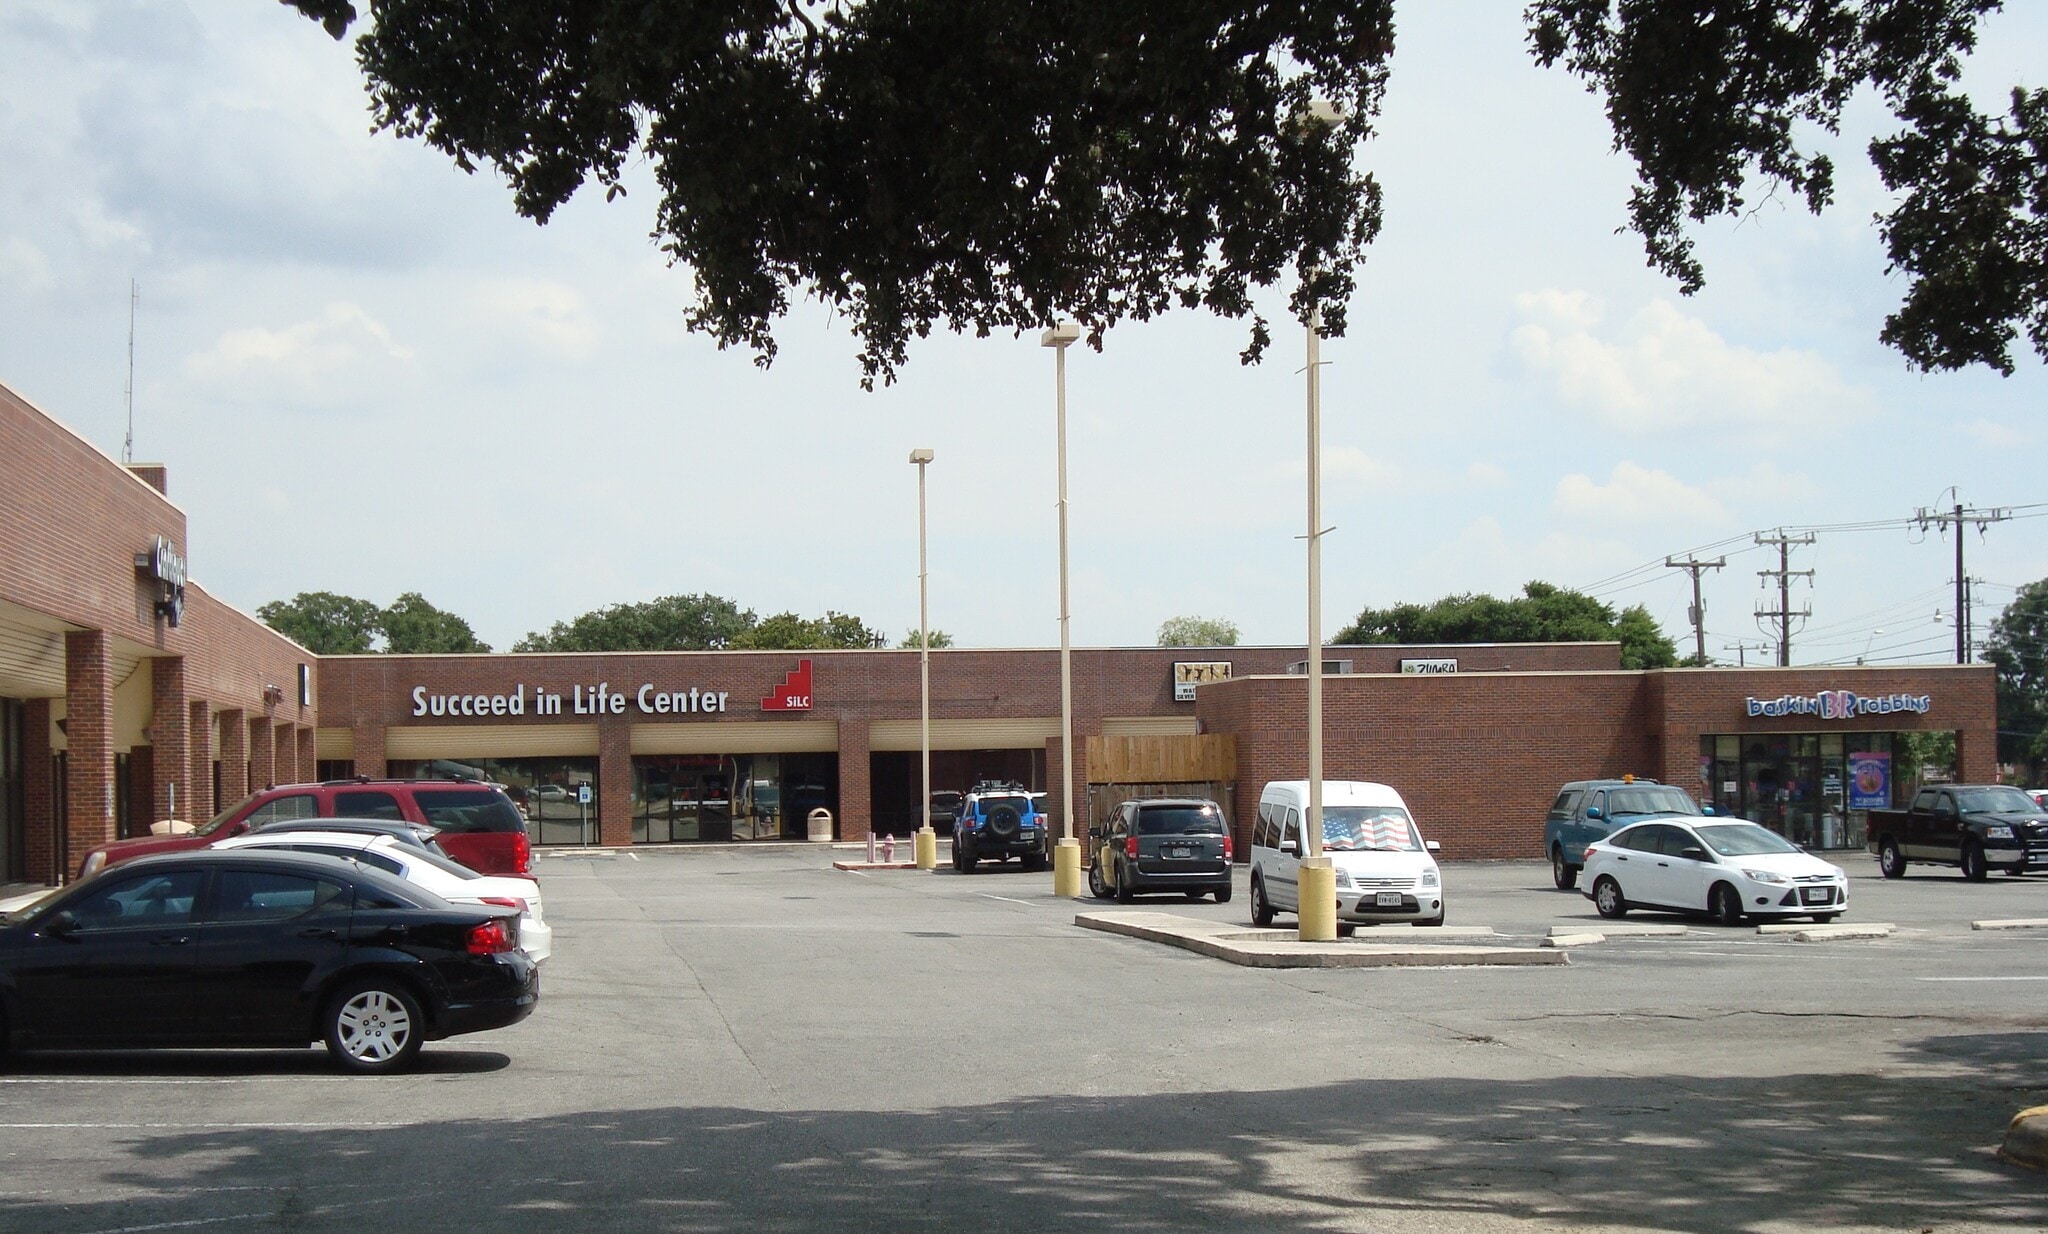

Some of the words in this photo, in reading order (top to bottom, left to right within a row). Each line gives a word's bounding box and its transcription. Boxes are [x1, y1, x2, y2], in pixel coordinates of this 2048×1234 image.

[1417, 663, 1455, 673] ZUMBA
[412, 683, 525, 717] Succeed
[536, 686, 562, 715] in
[574, 682, 626, 714] Life
[637, 683, 729, 714] Center
[1746, 695, 1818, 716] baskin
[1817, 690, 1857, 719] BR
[1857, 694, 1931, 714] robbins
